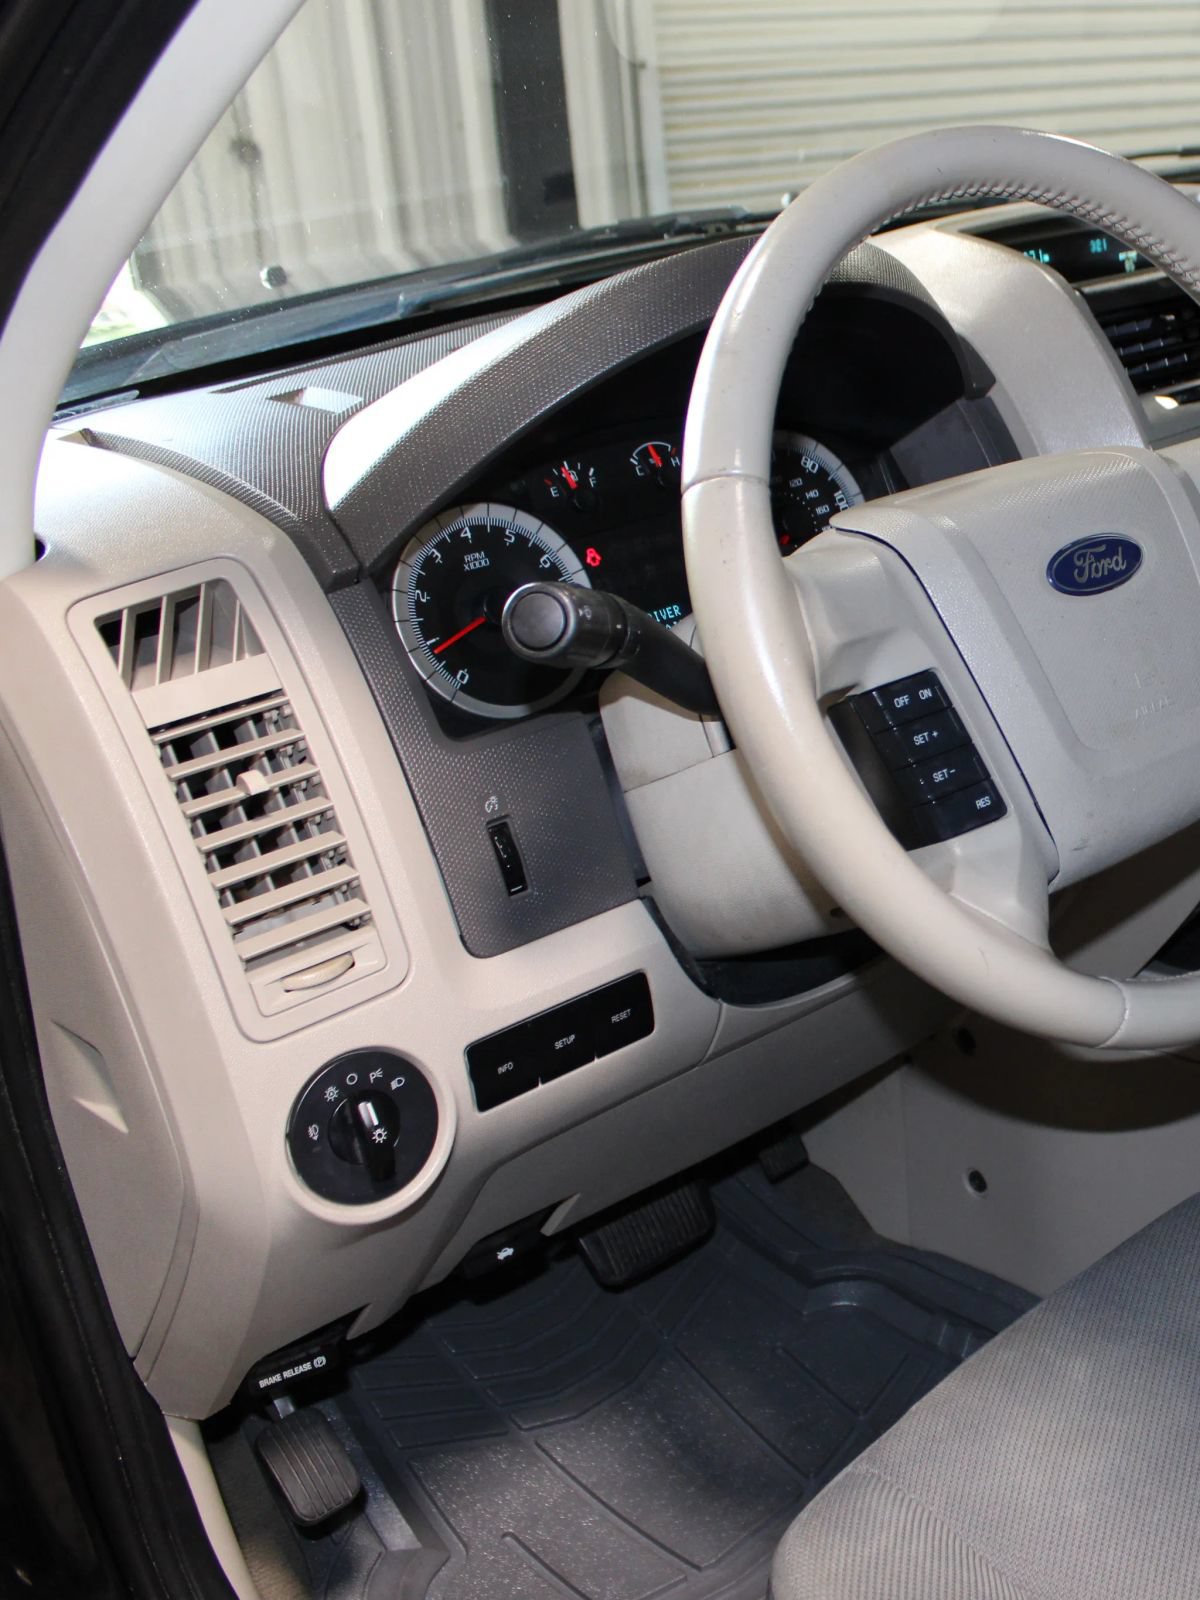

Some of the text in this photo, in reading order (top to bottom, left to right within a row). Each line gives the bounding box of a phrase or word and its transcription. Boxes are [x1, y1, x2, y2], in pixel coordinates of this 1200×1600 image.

[669, 456, 681, 468] H
[800, 455, 819, 474] 80
[589, 476, 597, 488] F
[550, 486, 560, 498] E
[805, 488, 820, 501] 140
[460, 526, 472, 539] 4
[504, 529, 517, 543] 5
[427, 548, 442, 563] 3
[464, 551, 486, 563] RPM
[540, 554, 552, 569] 6
[463, 558, 490, 572] X1000
[1073, 543, 1127, 584] Ford
[414, 589, 428, 603] 2
[647, 604, 682, 623] IVER
[893, 688, 933, 708] OFF ON
[913, 731, 929, 746] SET
[932, 768, 949, 783] SET
[975, 796, 992, 810] RES
[610, 1008, 632, 1024] RESET
[554, 1033, 576, 1050] SETUP
[497, 1060, 515, 1075] INFO
[258, 1361, 312, 1389] BRAKE RELEASE
